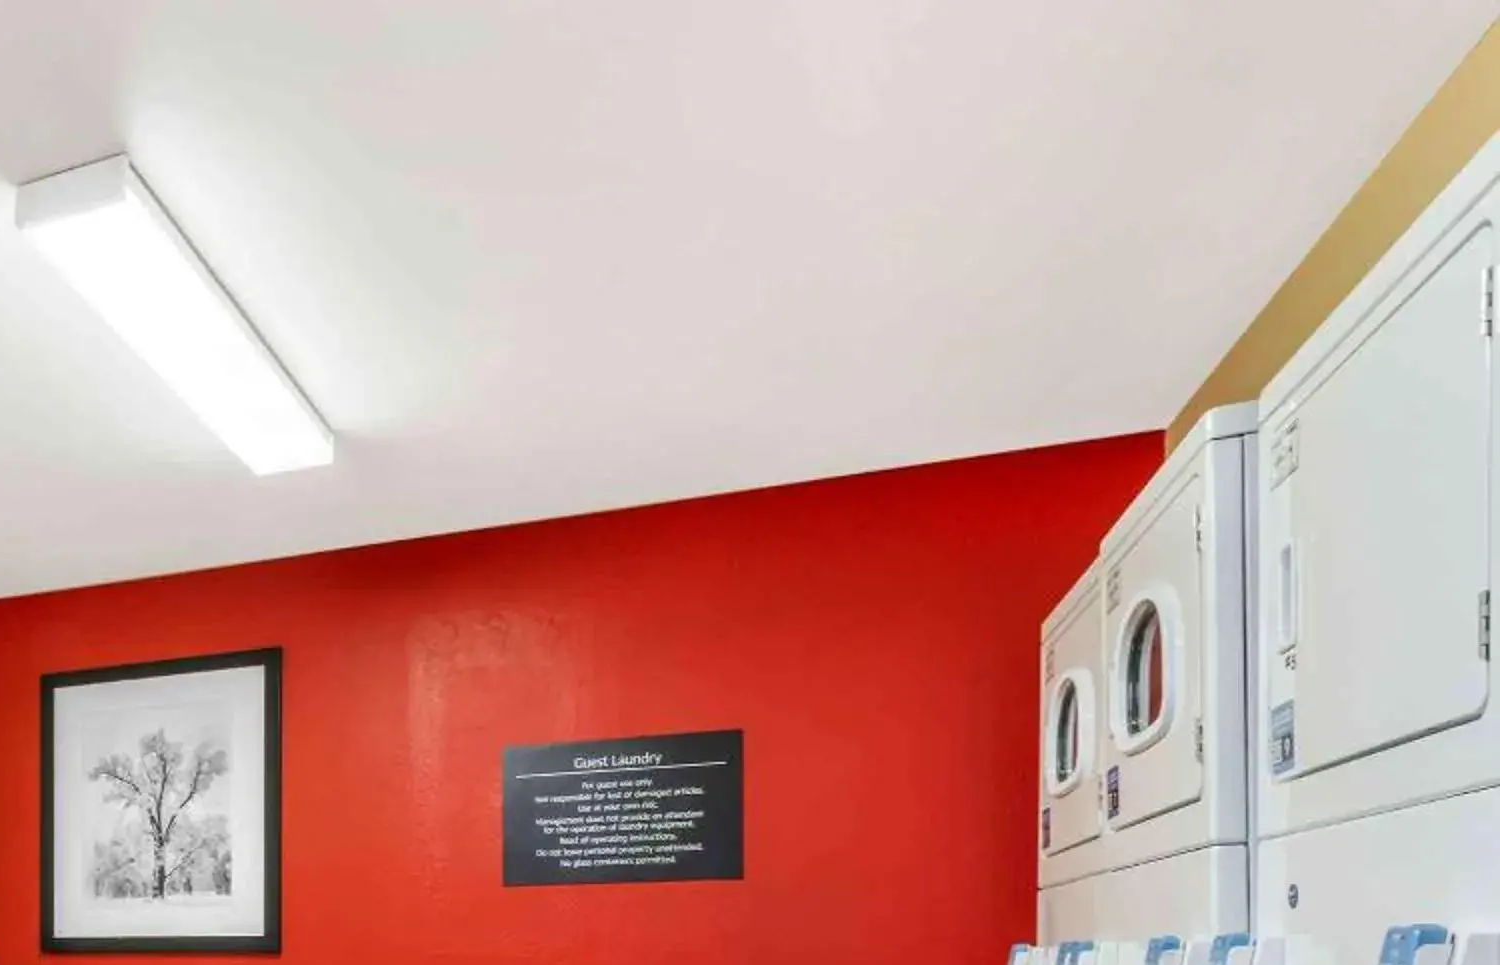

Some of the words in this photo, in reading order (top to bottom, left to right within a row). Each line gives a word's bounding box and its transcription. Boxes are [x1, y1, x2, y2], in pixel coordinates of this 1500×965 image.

[573, 755, 609, 769] Guest
[611, 751, 663, 767] Laundry
[595, 780, 618, 791] guest
[593, 791, 606, 801] for
[634, 788, 673, 799] damaged
[577, 804, 592, 813] Use
[603, 803, 620, 813] your
[621, 803, 640, 811] own
[535, 816, 584, 827] Management
[606, 815, 618, 823] not
[543, 827, 555, 835] for
[555, 826, 569, 834] the
[569, 825, 607, 835] operation
[617, 822, 649, 831] laundry
[590, 833, 628, 845] operating
[583, 846, 617, 857] personal
[618, 844, 653, 855] property
[573, 858, 592, 869] glass
